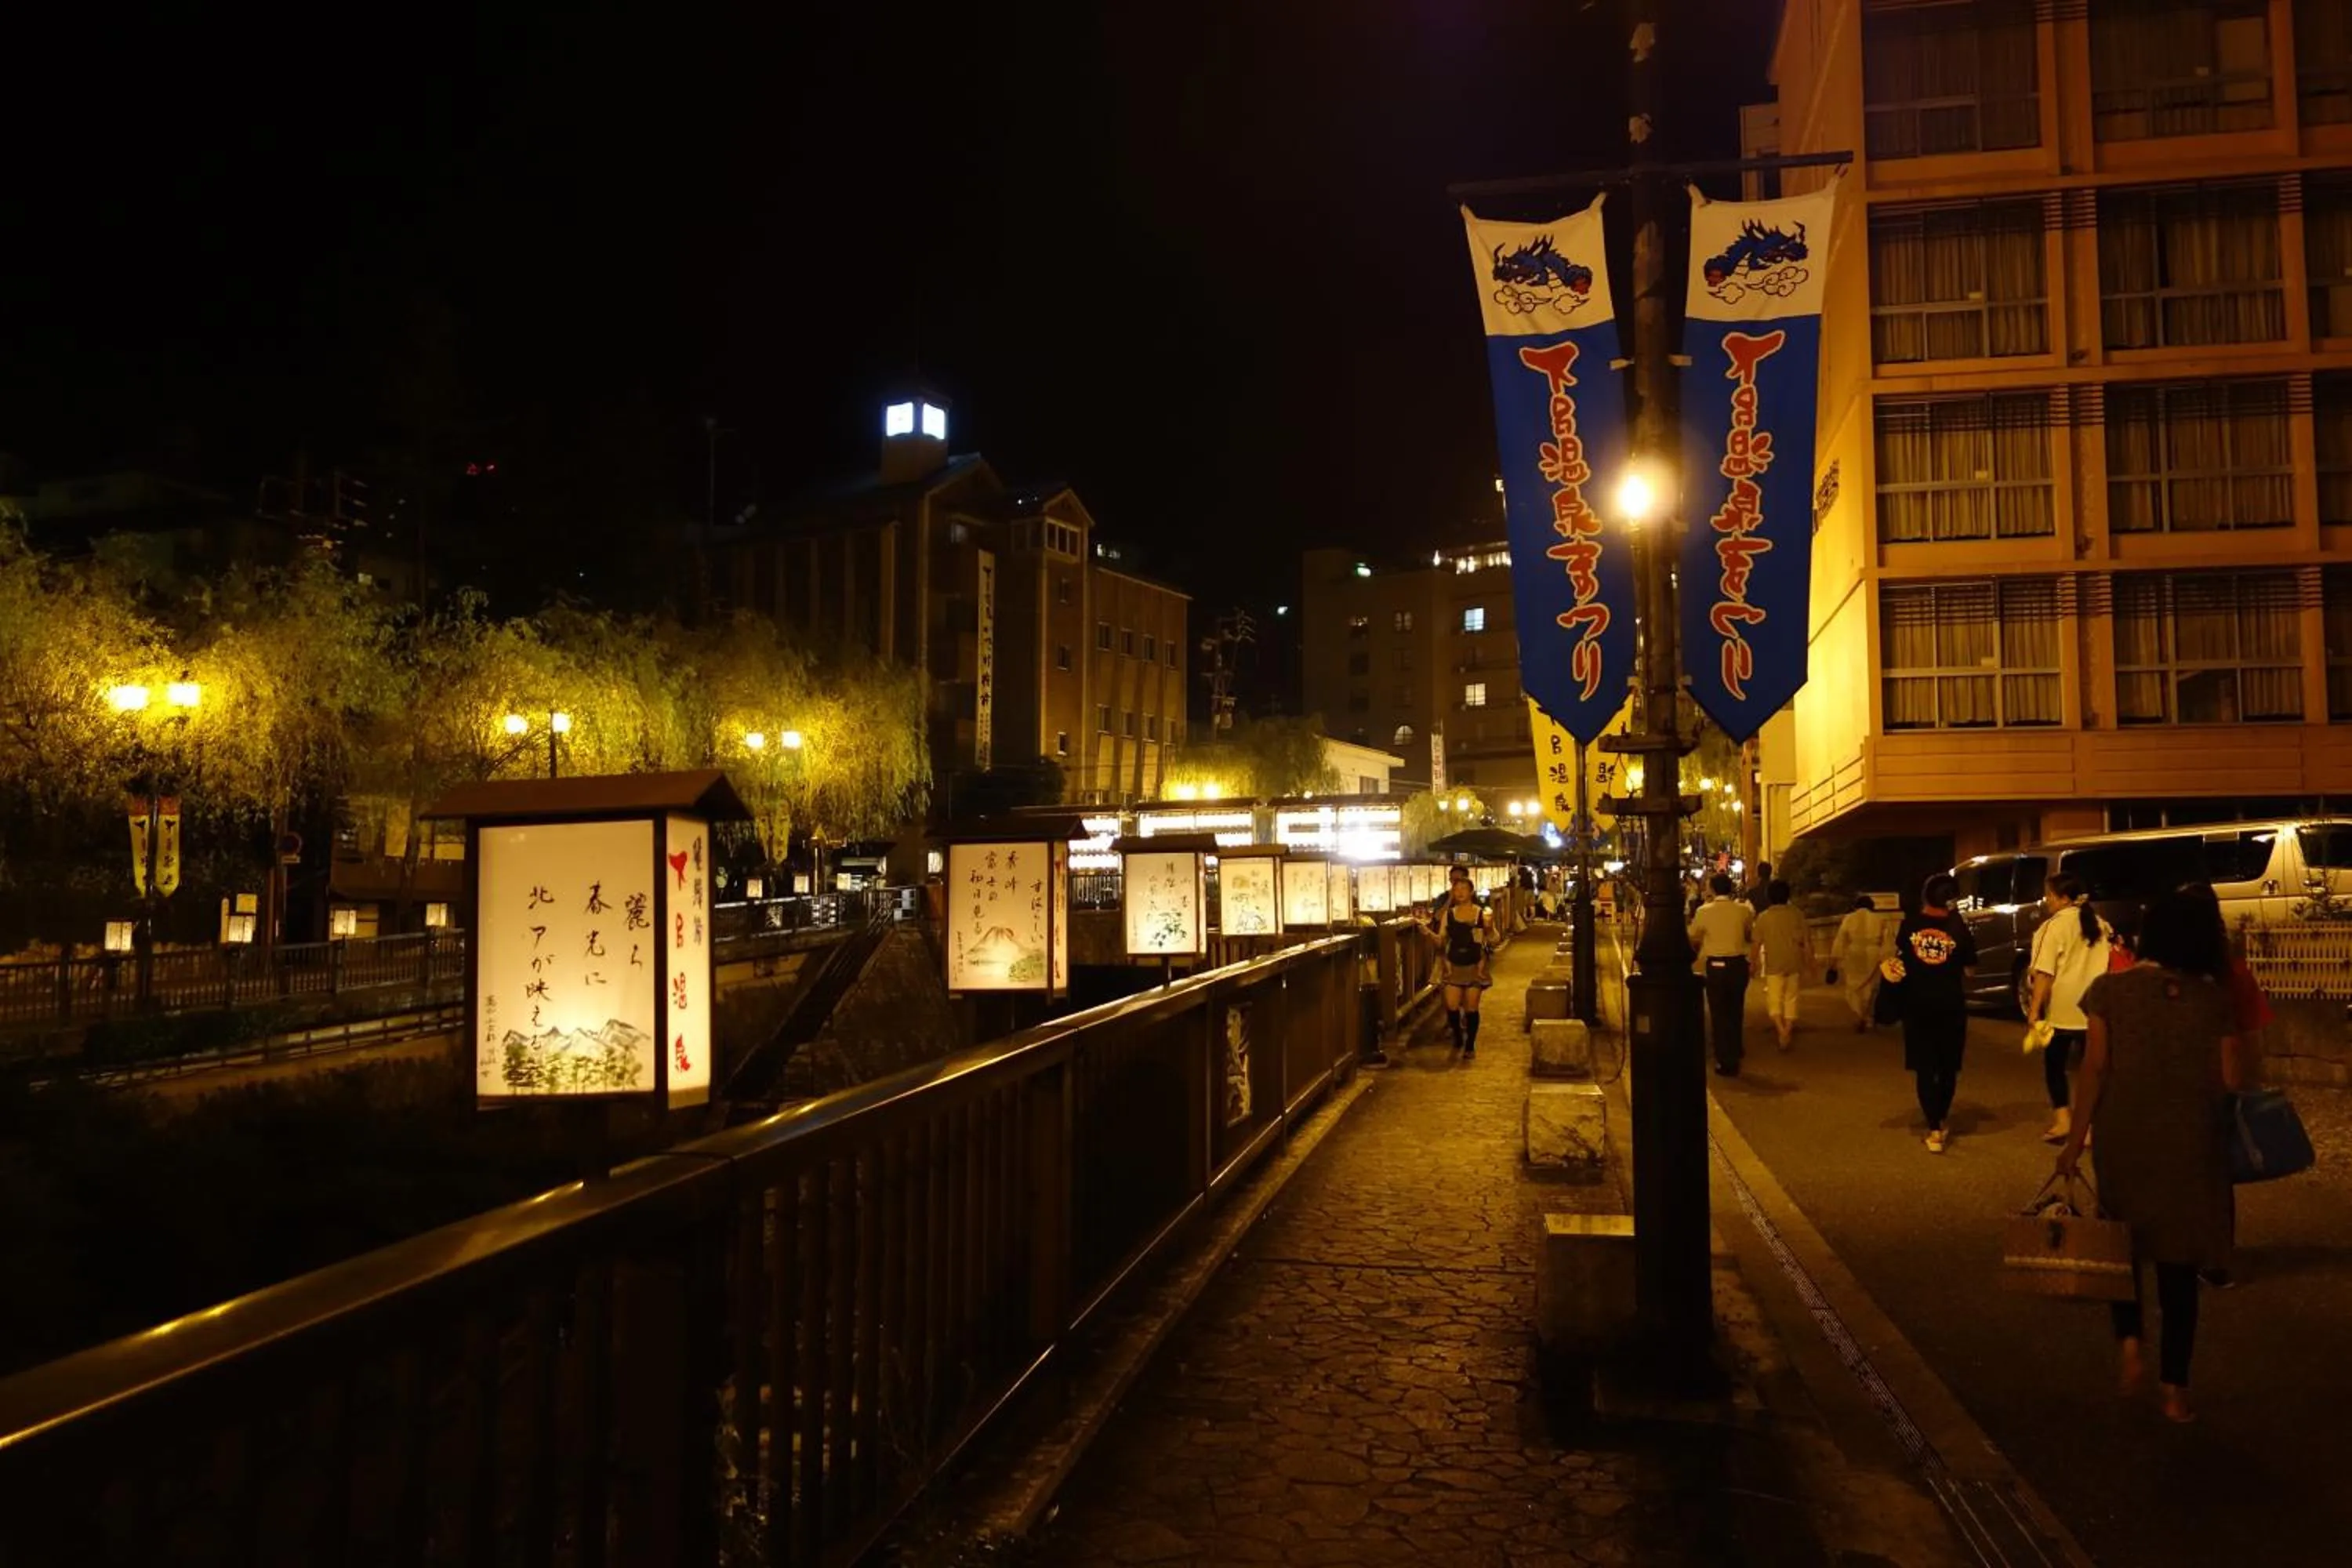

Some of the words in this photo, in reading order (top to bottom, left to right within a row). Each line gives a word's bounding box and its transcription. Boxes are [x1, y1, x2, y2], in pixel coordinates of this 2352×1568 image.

[1519, 341, 1610, 702] 下呂温泉まつり
[1537, 708, 1572, 813] 呂温泉
